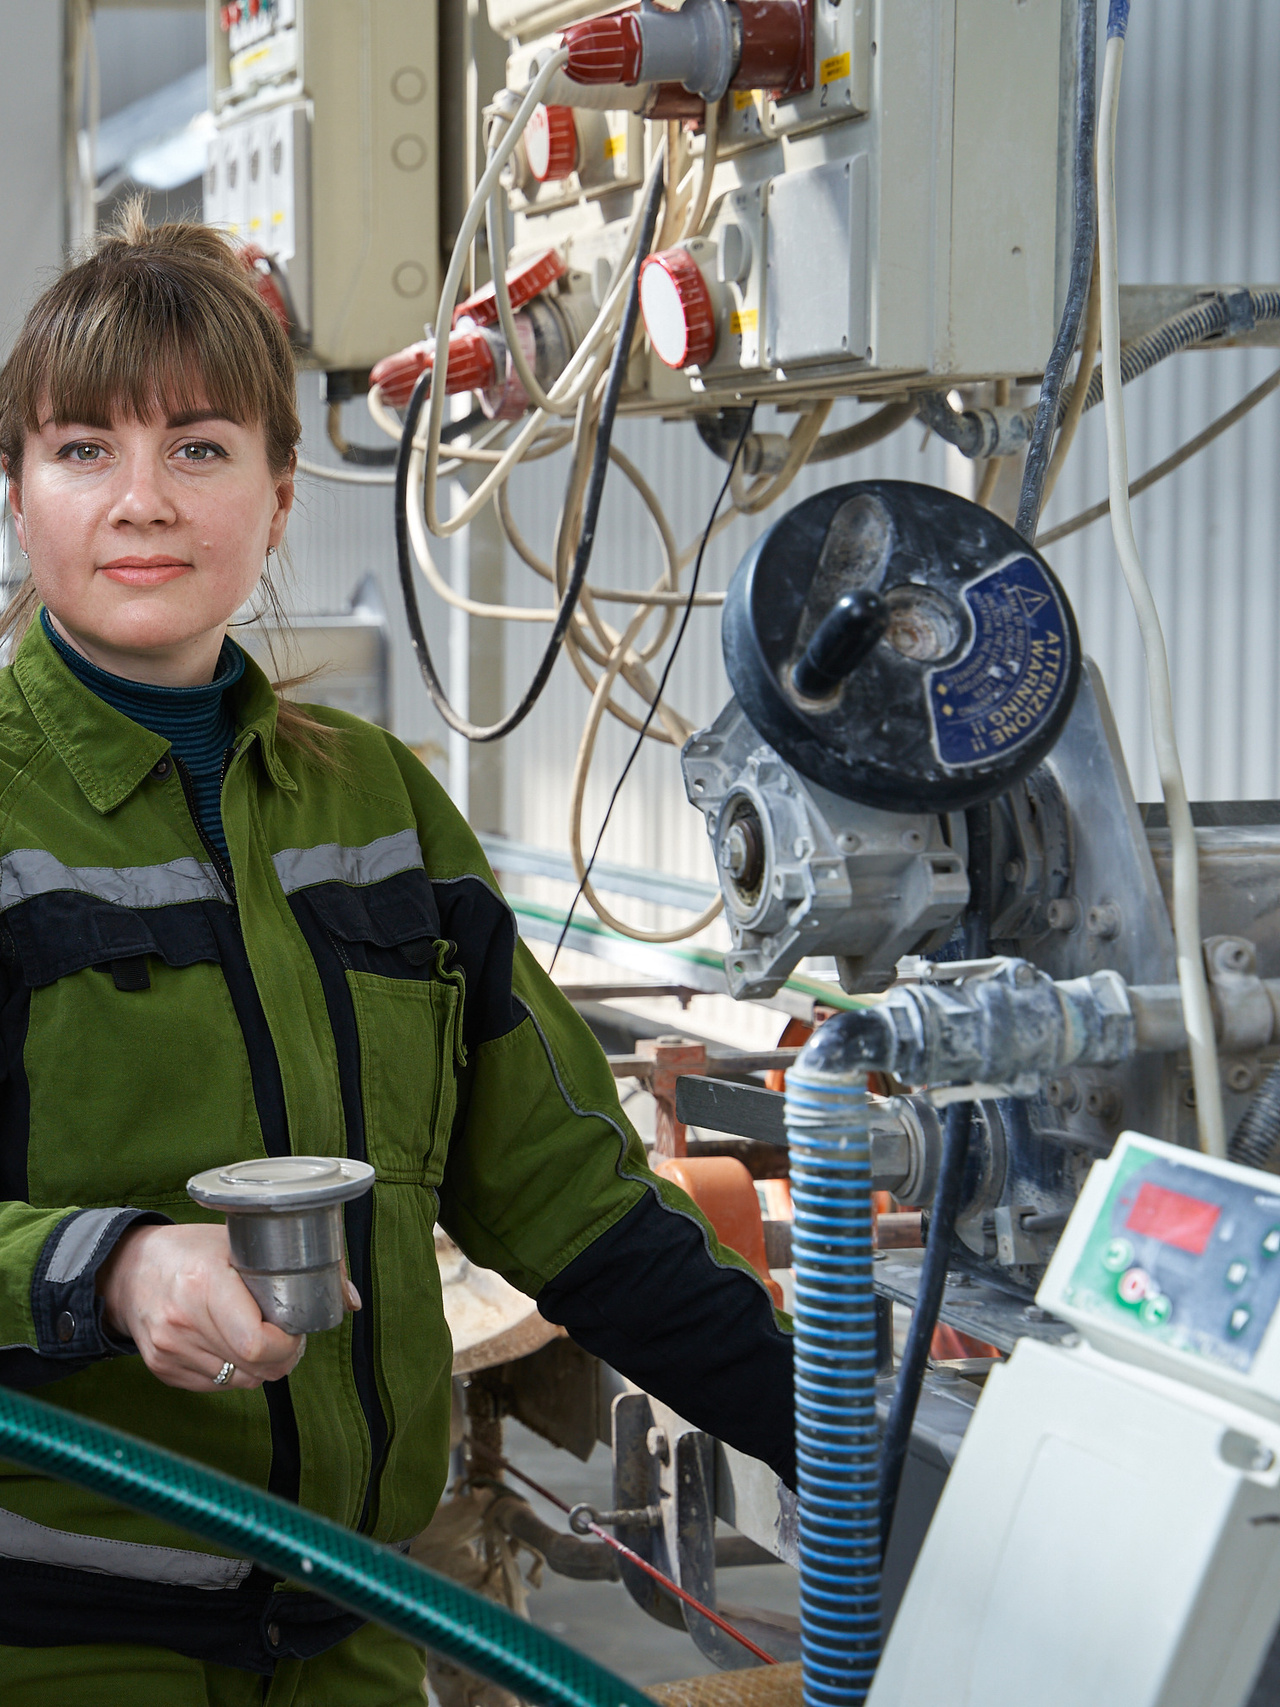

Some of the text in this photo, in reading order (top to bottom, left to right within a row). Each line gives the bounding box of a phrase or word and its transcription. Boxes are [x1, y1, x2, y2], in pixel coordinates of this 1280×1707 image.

[988, 640, 1045, 725] WARNING
[989, 630, 1060, 745] ATTENZIONE
[1007, 629, 1025, 674] RUOTA
